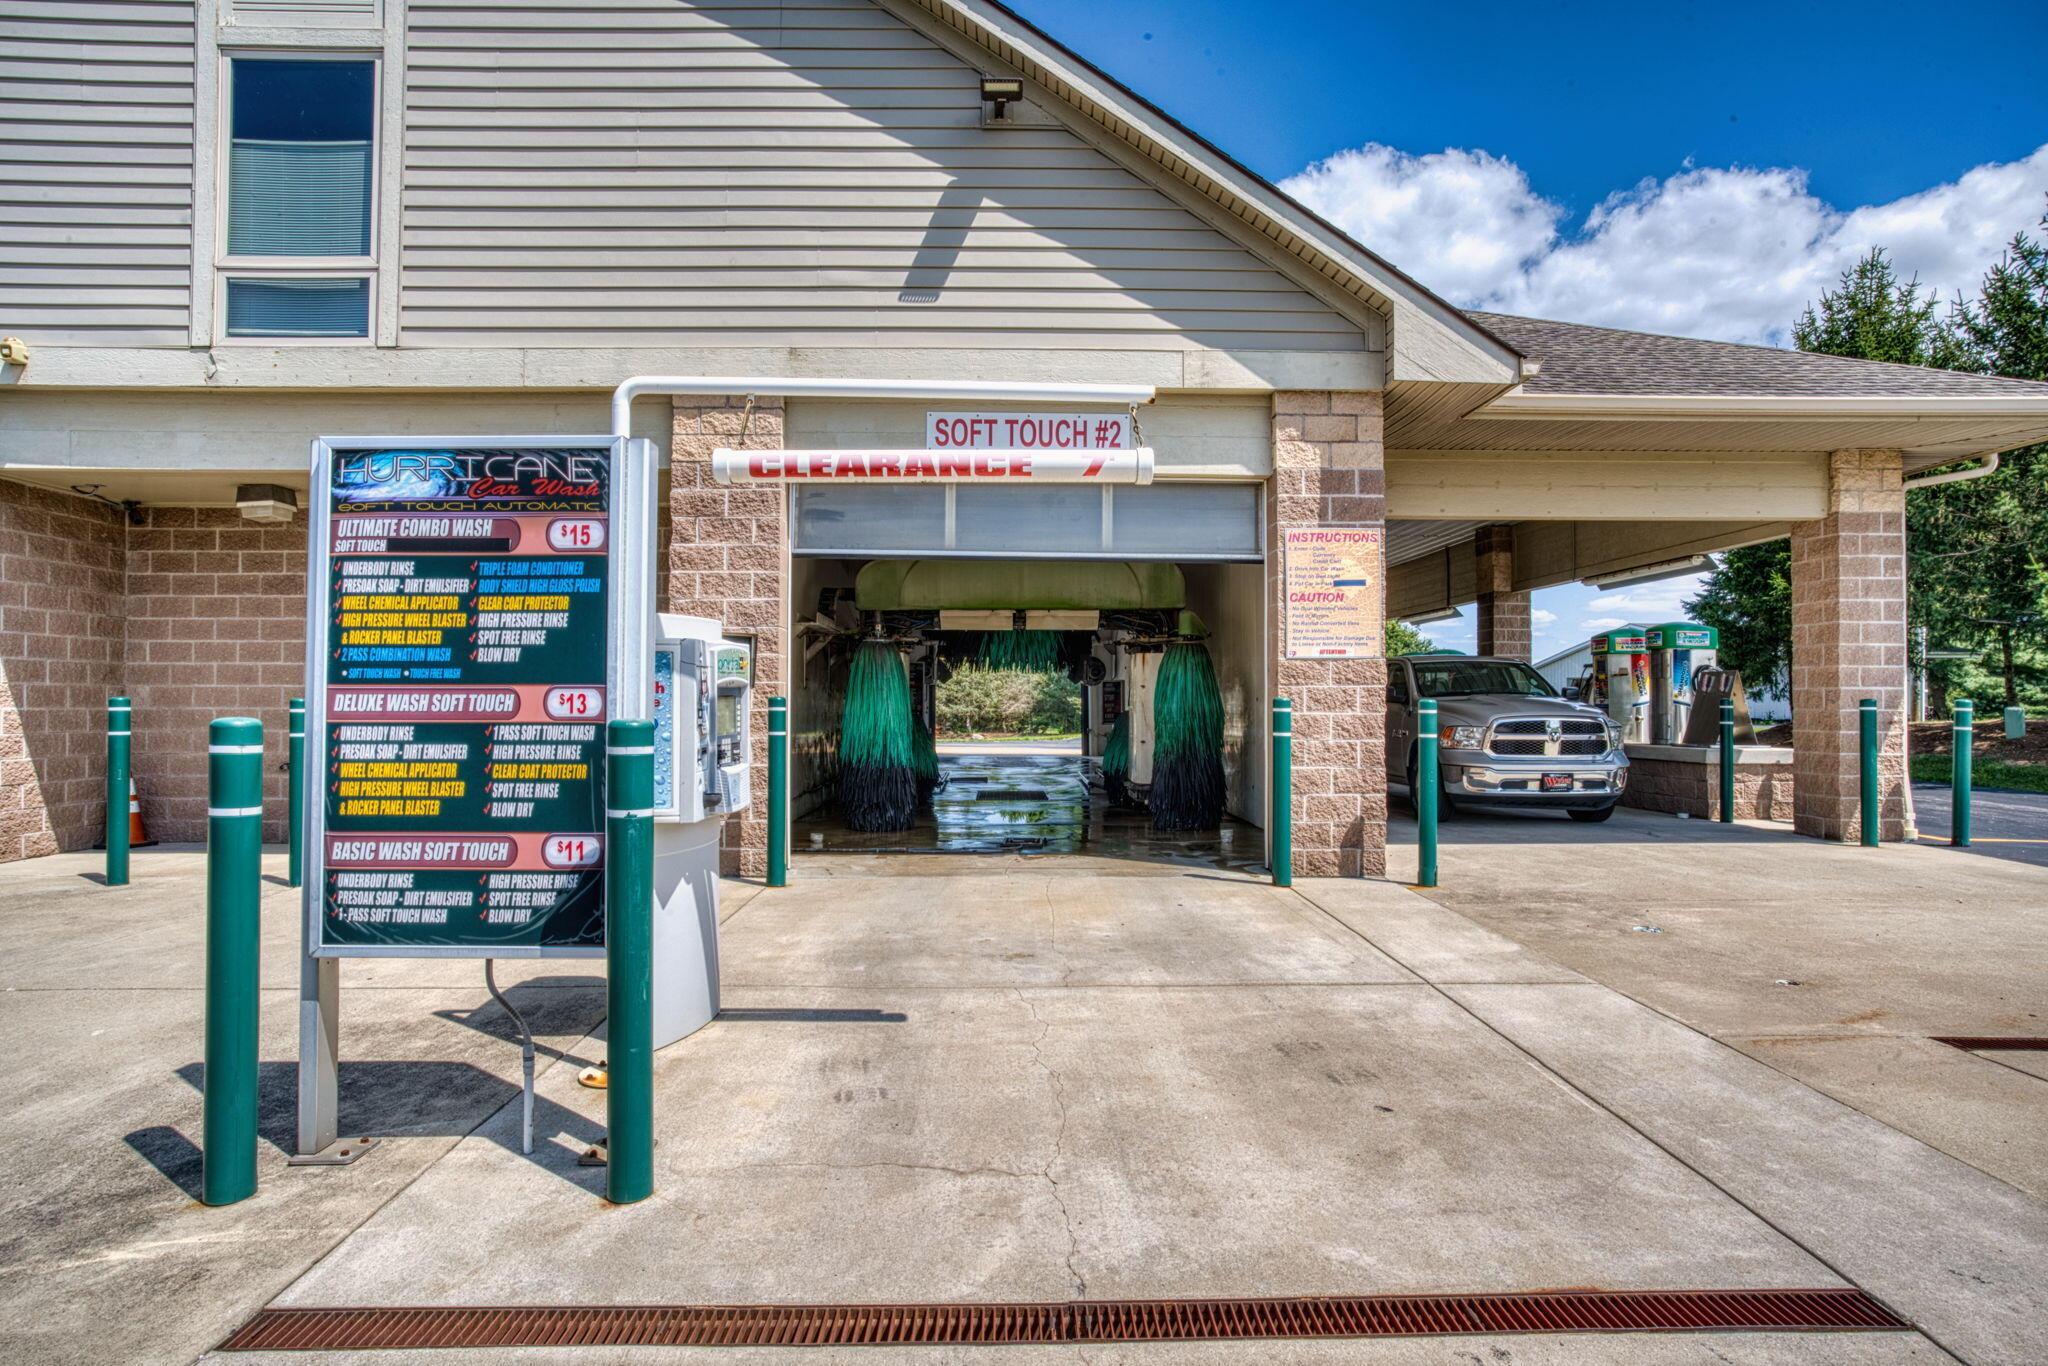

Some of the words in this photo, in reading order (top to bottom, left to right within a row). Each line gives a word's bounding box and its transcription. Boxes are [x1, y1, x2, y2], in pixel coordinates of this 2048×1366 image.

[934, 418, 998, 447] SOFT
[1004, 418, 1088, 447] TOUCH
[1095, 418, 1122, 447] #2
[340, 455, 600, 483] HURRICANE
[748, 453, 1032, 478] CLEARANCE
[468, 477, 520, 499] Car
[531, 478, 600, 497] Wash
[338, 502, 390, 512] SOFT
[409, 502, 477, 512] TOUCH
[482, 502, 600, 512] AUTOMATIC
[337, 519, 397, 537] ULTIMATE
[400, 519, 449, 537] COMBO
[452, 519, 493, 537] WASH
[561, 525, 591, 546] $15
[1288, 532, 1378, 542] INSTRUCTIONS
[335, 541, 355, 552] SOFT
[357, 541, 387, 552] TOUCH
[342, 562, 390, 576] UNDERBODY
[390, 562, 415, 576] RINSE
[480, 562, 506, 576] TRIPLE
[506, 562, 529, 576] FOAM
[531, 562, 584, 576] CONDITIONER
[342, 578, 378, 592] PRESOAK
[378, 578, 400, 592] SOAP
[404, 578, 424, 592] DIRT
[424, 578, 470, 592] EMULSIFIER
[478, 579, 500, 592] BODY
[501, 579, 528, 592] SHIELD
[529, 579, 548, 592] HIGH
[549, 579, 573, 592] GLOSS
[574, 579, 601, 592] POLISH
[342, 596, 368, 610] WHEEL
[369, 596, 409, 610] CHEMICAL
[410, 596, 459, 610] APPLICATOR
[478, 596, 503, 610] CLEAR
[503, 596, 524, 610] COAT
[524, 596, 569, 610] PROTECTOR
[1290, 592, 1344, 602] CAUTION
[342, 613, 361, 627] HIGH
[362, 613, 404, 627] PRESSURE
[404, 613, 431, 627] WHEEL
[432, 613, 467, 627] BLASTER
[478, 613, 500, 627] HIGH
[500, 613, 543, 627] PRESSURE
[543, 613, 568, 627] RINSE
[342, 630, 348, 644] &
[349, 630, 381, 644] ROCKER
[381, 630, 407, 644] PANEL
[407, 630, 442, 644] BLASTER
[478, 630, 501, 644] SPOT
[501, 630, 520, 644] FREE
[521, 630, 546, 644] RINSE
[342, 648, 348, 661] 2
[348, 648, 369, 661] PASS
[369, 648, 427, 661] COMBINATION
[427, 648, 452, 661] WASH
[478, 648, 503, 662] BLOW
[503, 648, 521, 662] DRY
[349, 668, 364, 678] SOFT
[364, 668, 382, 678] TOUCH
[383, 668, 401, 678] WASH
[410, 668, 428, 678] TOUCH
[428, 668, 442, 678] FREE
[443, 668, 461, 678] WASH
[334, 694, 383, 712] DELUXE
[386, 694, 429, 712] WASH
[431, 694, 467, 712] SOFT
[469, 694, 515, 712] TOUCH
[560, 694, 587, 714] $13
[340, 726, 388, 740] UNDERBODY
[389, 726, 414, 740] RINSE
[494, 726, 498, 740] 1
[500, 726, 520, 740] PASS
[521, 726, 542, 740] SOFT
[542, 726, 570, 740] TOUCH
[570, 726, 596, 740] WASH
[340, 744, 377, 760] PRESOAK
[377, 744, 399, 760] SOAP
[403, 744, 423, 760] DIRT
[423, 744, 468, 760] EMULSIFIER
[492, 744, 514, 760] HIGH
[515, 744, 556, 760] PRESSURE
[557, 744, 582, 760] RINSE
[340, 763, 366, 778] WHEEL
[368, 763, 408, 778] CHEMICAL
[409, 763, 458, 778] APPLICATOR
[492, 764, 518, 779] CLEAR
[519, 764, 541, 779] COAT
[541, 764, 588, 779] PROTECTOR
[340, 782, 360, 796] HIGH
[360, 782, 402, 796] PRESSURE
[403, 782, 430, 796] WHEEL
[430, 782, 465, 796] BLASTER
[492, 783, 514, 798] SPOT
[514, 783, 534, 798] FREE
[534, 783, 560, 798] RINSE
[340, 800, 346, 815] &
[347, 800, 379, 815] ROCKER
[380, 800, 405, 815] PANEL
[405, 800, 440, 815] BLASTER
[492, 802, 516, 817] BLOW
[516, 802, 534, 817] DRY
[332, 842, 376, 860] BASIC
[378, 842, 422, 860] WASH
[424, 842, 460, 860] SOFT
[462, 842, 509, 860] TOUCH
[558, 841, 585, 861] $11
[338, 874, 388, 888] UNDERBODY
[388, 874, 414, 888] RINSE
[489, 874, 512, 889] HIGH
[512, 874, 554, 889] PRESSURE
[554, 874, 579, 889] RINSE
[338, 891, 376, 906] PRESOAK
[376, 891, 399, 906] SOAP
[404, 891, 425, 906] DIRT
[425, 891, 473, 906] EMULSIFIER
[489, 892, 512, 906] SPOT
[512, 892, 531, 906] FREE
[532, 892, 557, 906] RINSE
[348, 908, 370, 922] PASS
[370, 908, 392, 922] SOFT
[392, 908, 422, 922] TOUCH
[422, 908, 448, 922] WASH
[488, 909, 514, 923] BLOW
[515, 909, 532, 923] DRY
